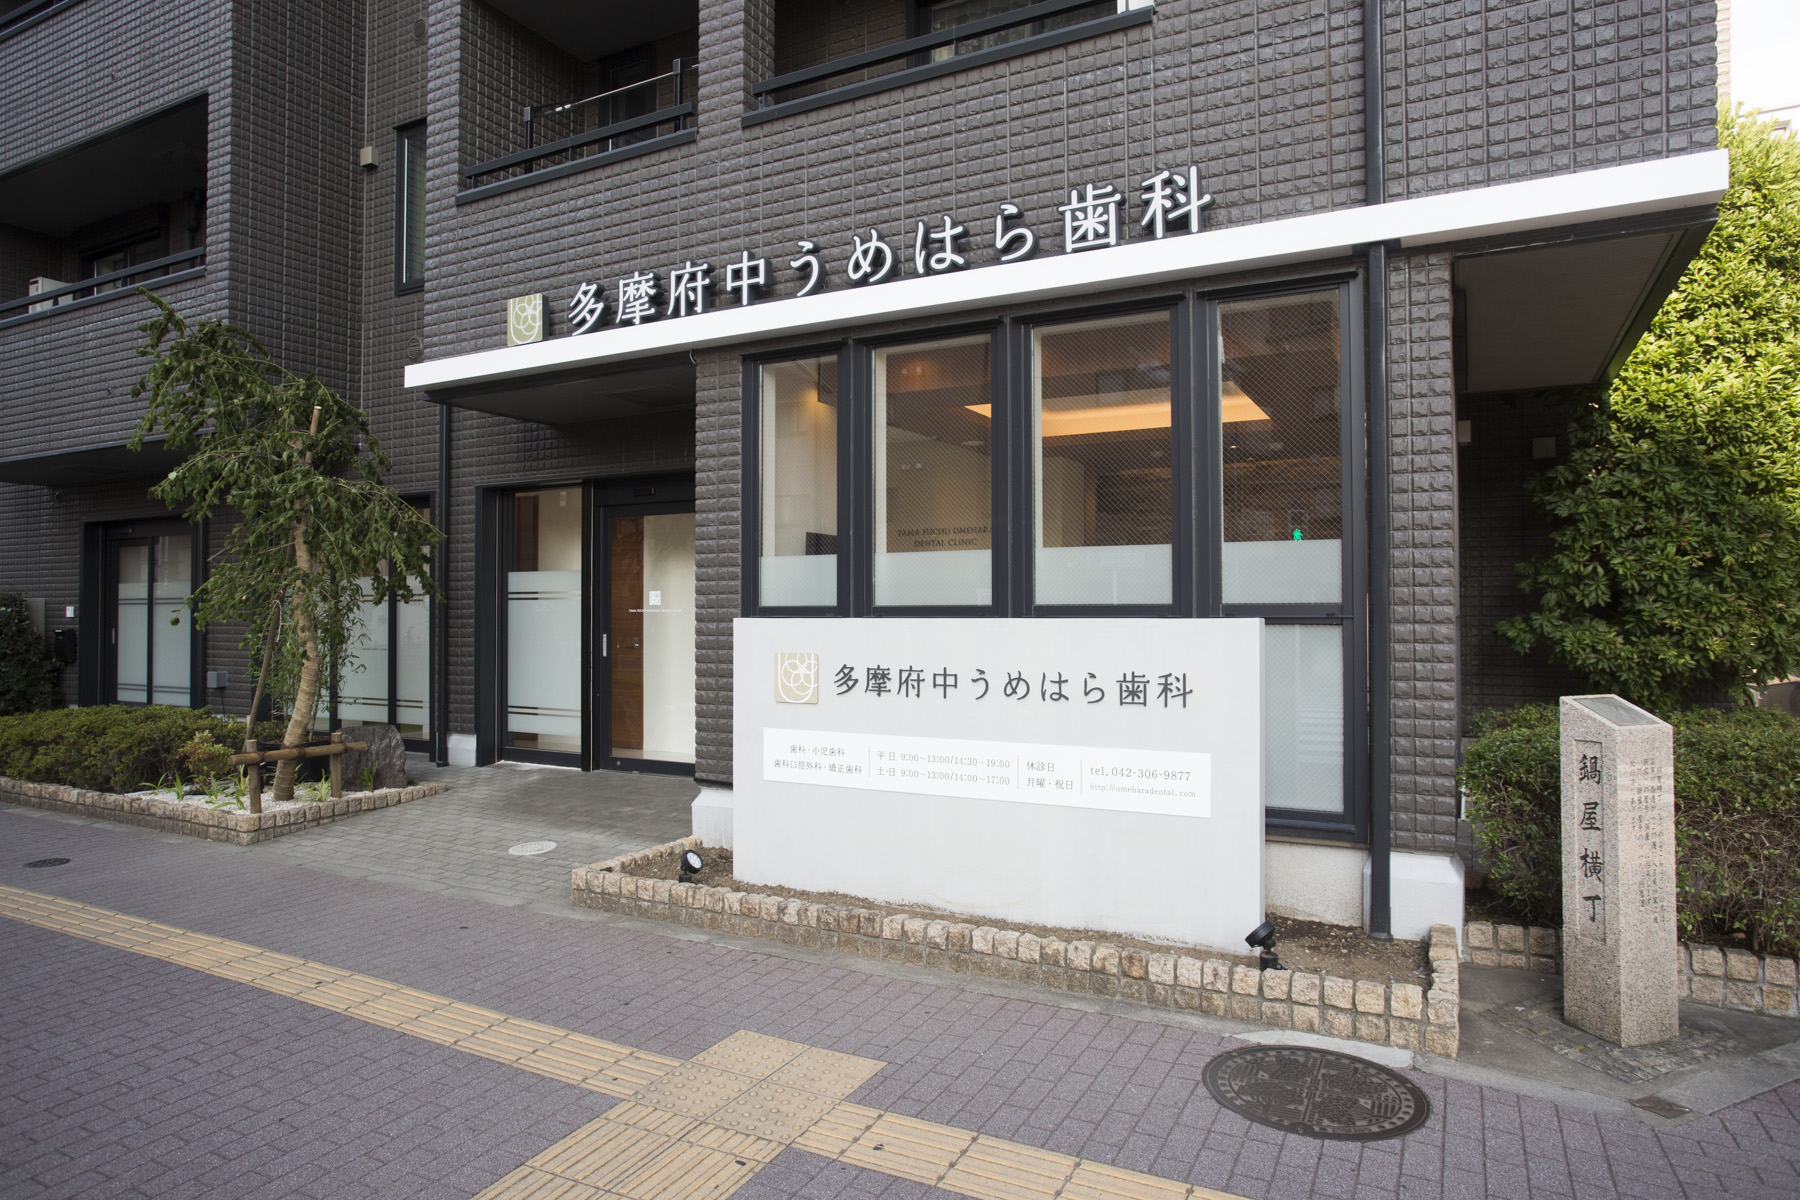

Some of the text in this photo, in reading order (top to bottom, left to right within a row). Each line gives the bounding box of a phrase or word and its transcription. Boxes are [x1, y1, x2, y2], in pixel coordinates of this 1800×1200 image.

[567, 165, 1212, 337] 多摩府中うめはら歯科
[897, 529, 920, 537] TAMA
[914, 538, 977, 548] DENTAL CLINIC
[832, 663, 1194, 709] 多摩府中うめはら歯科
[1026, 760, 1055, 772] 休診日
[1578, 753, 1604, 923] 鍋屋横丁
